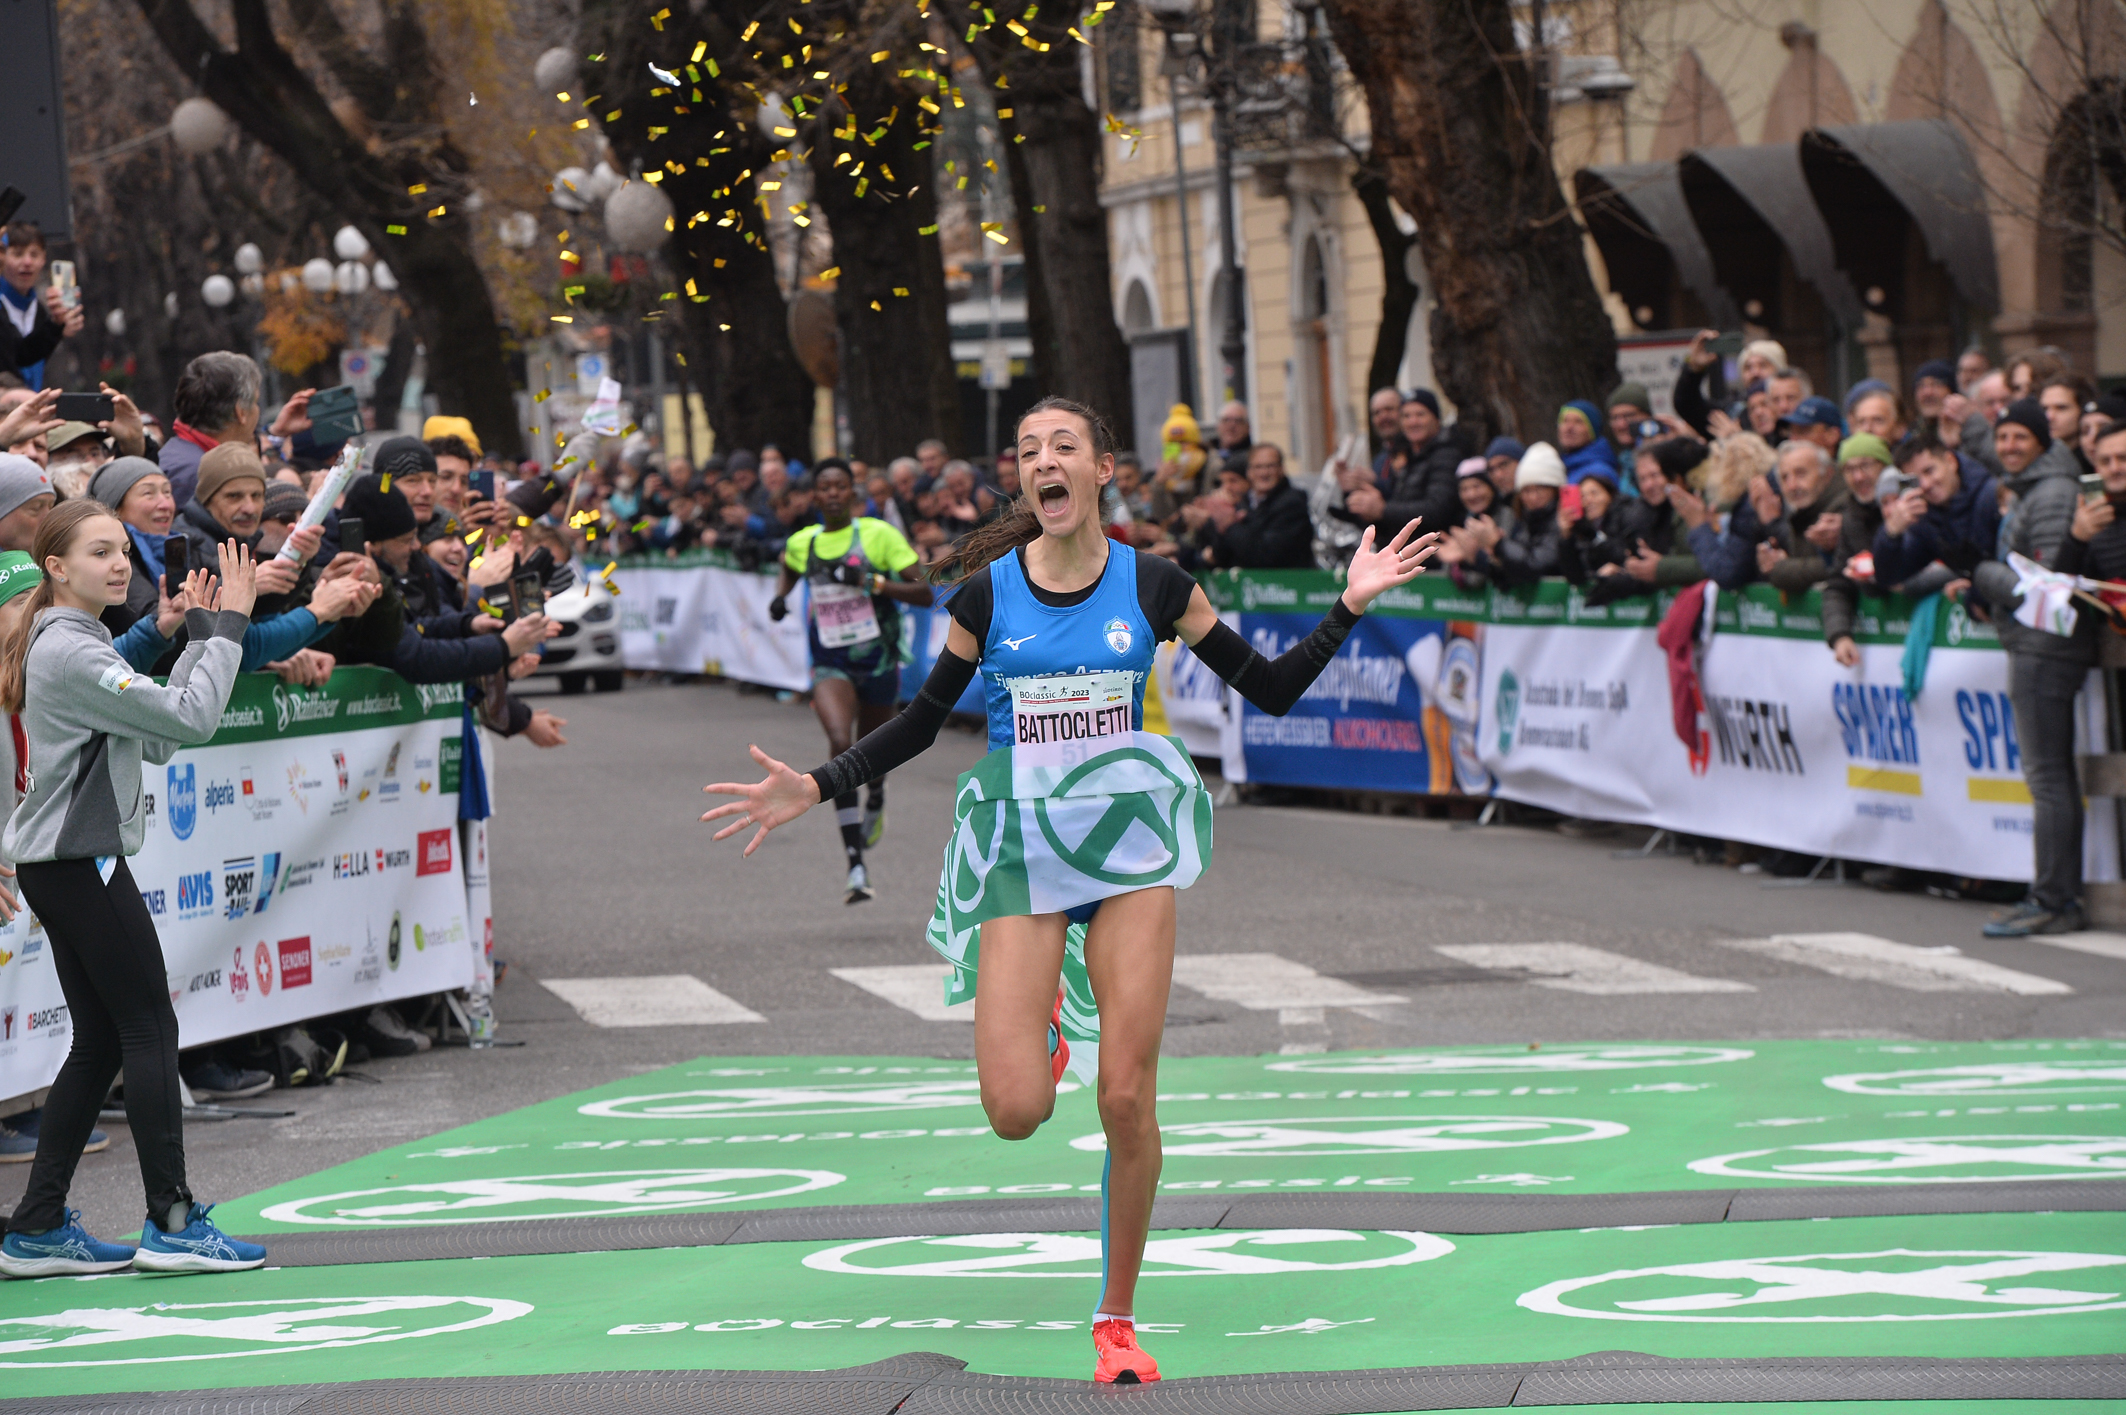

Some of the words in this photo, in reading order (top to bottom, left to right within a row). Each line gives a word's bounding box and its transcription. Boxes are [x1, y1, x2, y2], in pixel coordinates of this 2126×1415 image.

[1019, 690, 1056, 700] BOclassic
[1071, 689, 1090, 697] 2023
[1018, 704, 1128, 743] BATTOCLETTI
[205, 778, 234, 815] alperia
[333, 852, 369, 880] HELLA
[178, 871, 213, 911] AVIS
[225, 872, 254, 898] SPORT
[32, 1005, 68, 1030] BARCHETTI
[924, 1175, 1415, 1198] BOcassic
[607, 1316, 1185, 1336] BOclassc
